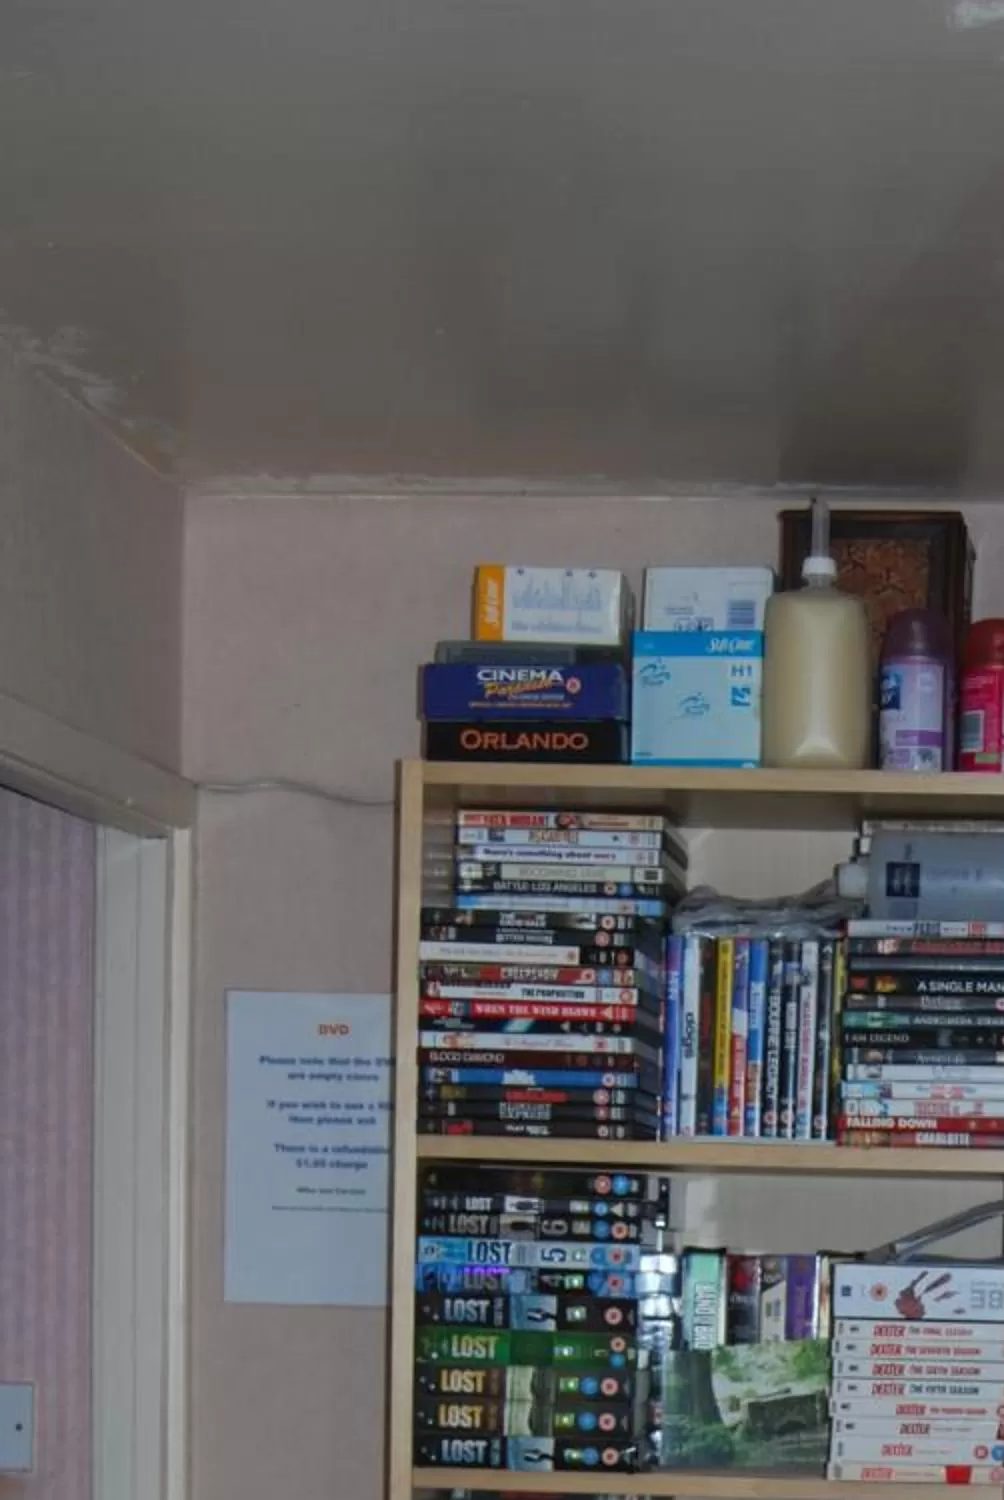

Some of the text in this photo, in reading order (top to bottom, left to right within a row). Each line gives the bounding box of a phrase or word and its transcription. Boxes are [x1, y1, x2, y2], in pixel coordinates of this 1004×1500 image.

[477, 667, 564, 682] CINEMA
[460, 730, 588, 750] ORLANDO
[929, 981, 973, 993] SINGLE
[318, 1024, 350, 1036] DVD
[450, 1213, 490, 1235] LOST
[467, 1241, 513, 1265] LOST
[444, 1299, 490, 1323] LOST
[451, 1335, 499, 1360] LOST
[440, 1369, 487, 1394] LOST
[438, 1404, 484, 1429] LOST
[441, 1440, 489, 1463] LOST
